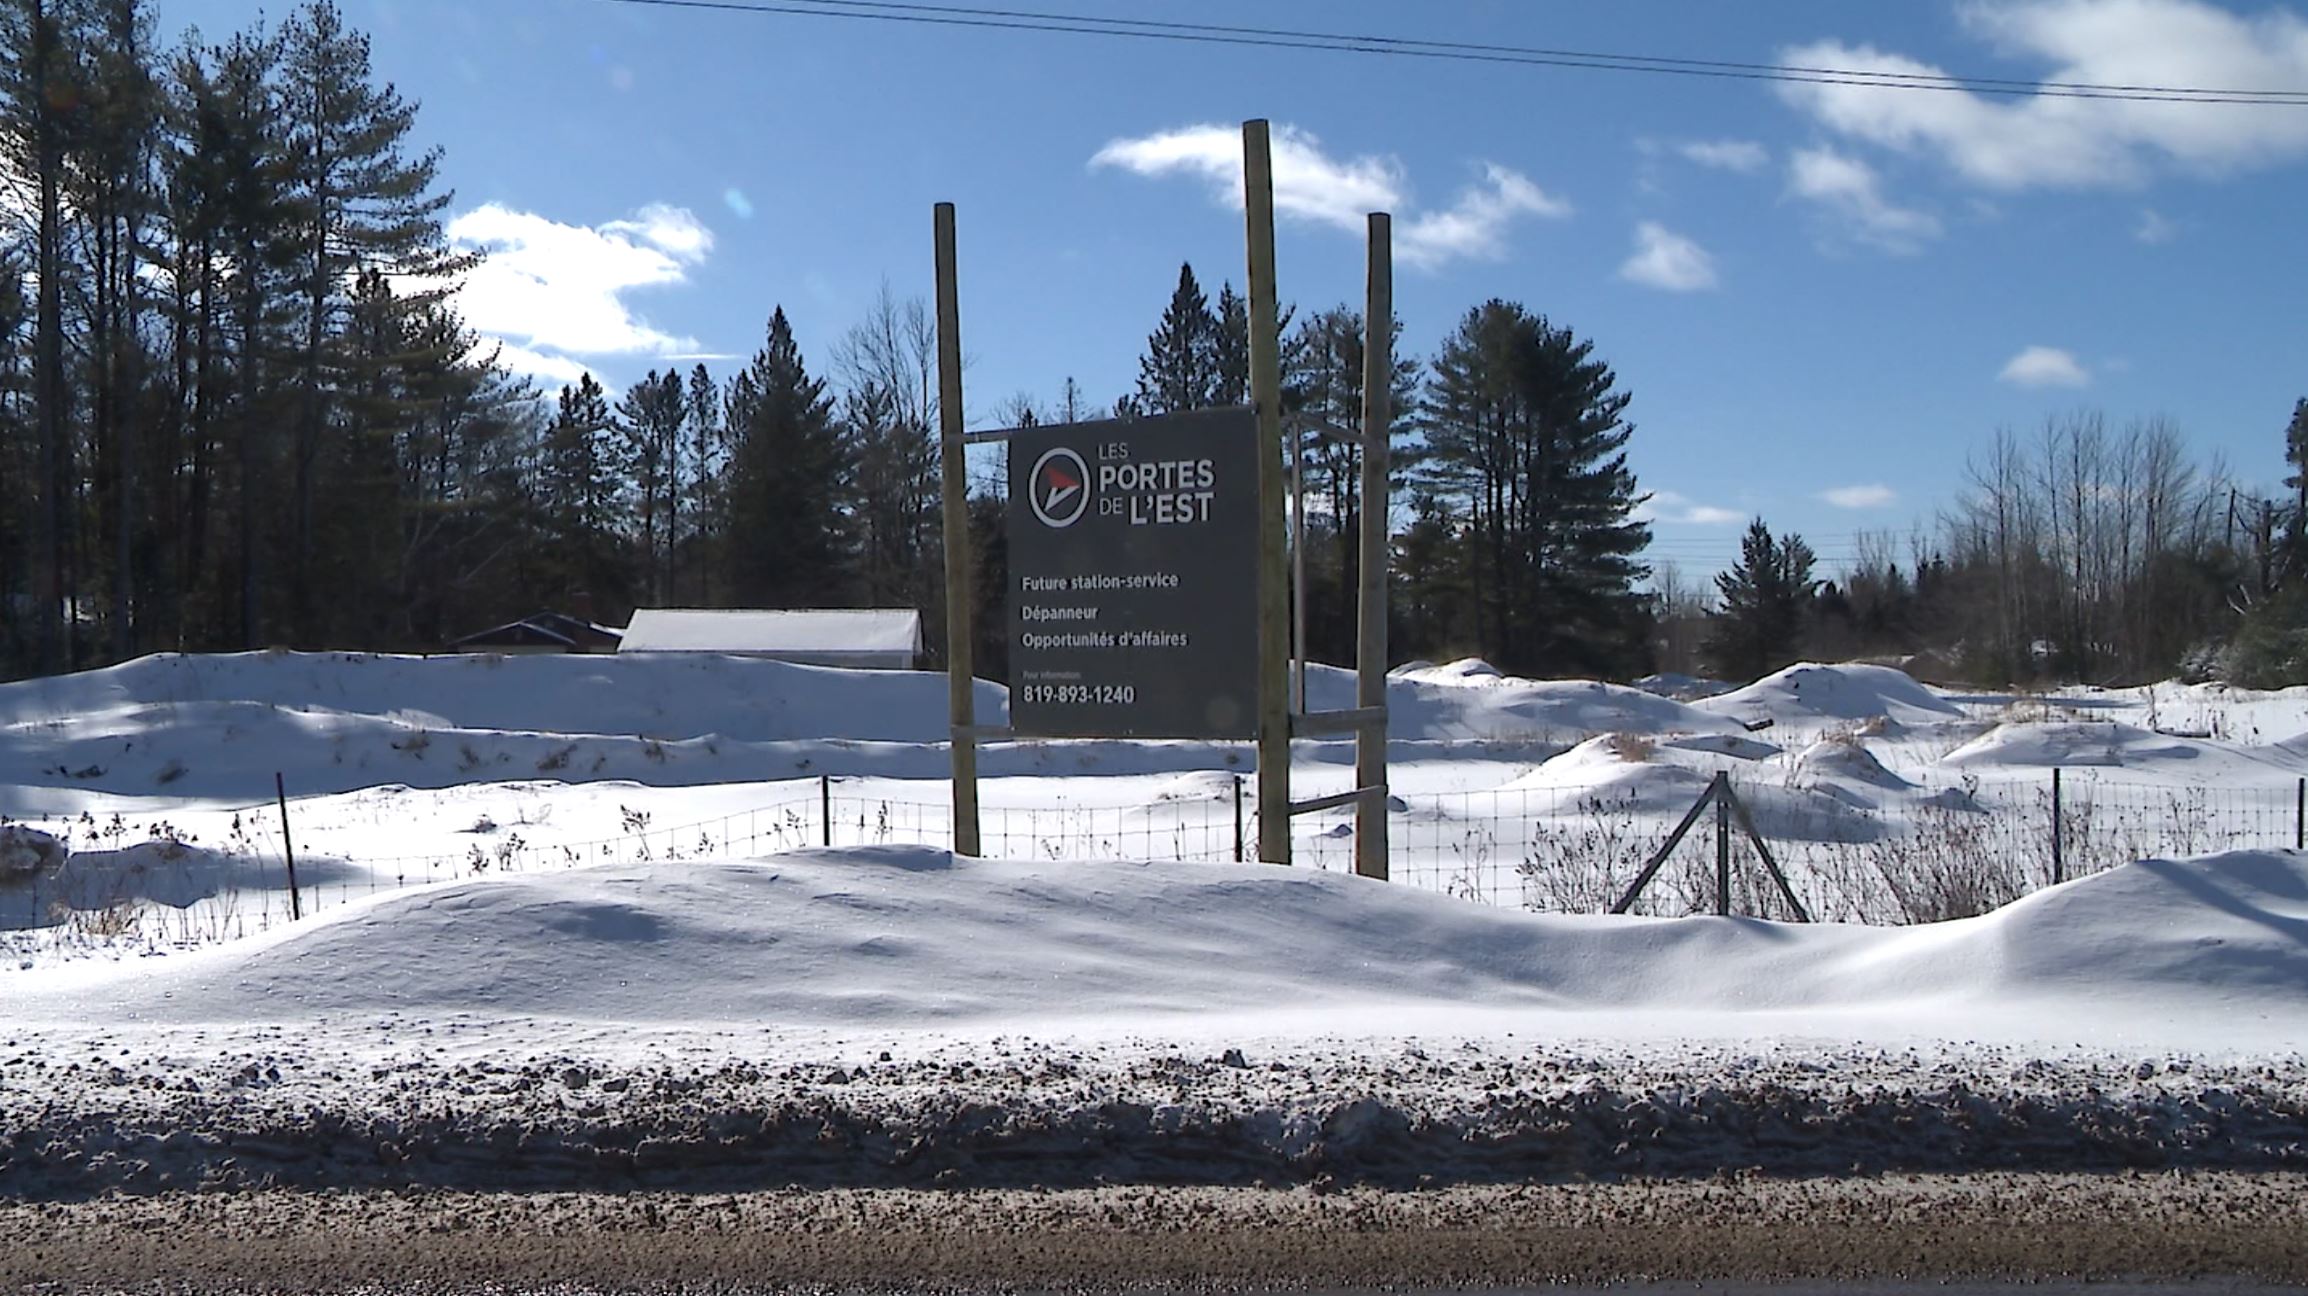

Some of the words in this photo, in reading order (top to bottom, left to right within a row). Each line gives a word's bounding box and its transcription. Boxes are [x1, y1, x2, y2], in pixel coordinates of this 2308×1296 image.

[1099, 442, 1129, 460] LES
[1100, 460, 1214, 492] PORTES
[1100, 497, 1123, 515] DE
[1130, 492, 1214, 525] L'EST
[1022, 576, 1067, 591] Future
[1071, 572, 1179, 590] station-service
[1022, 605, 1098, 622] Dépanneur
[1022, 632, 1114, 649] Opportunités
[1118, 630, 1188, 647] d'affaires
[1023, 686, 1135, 703] 819-893-1240
